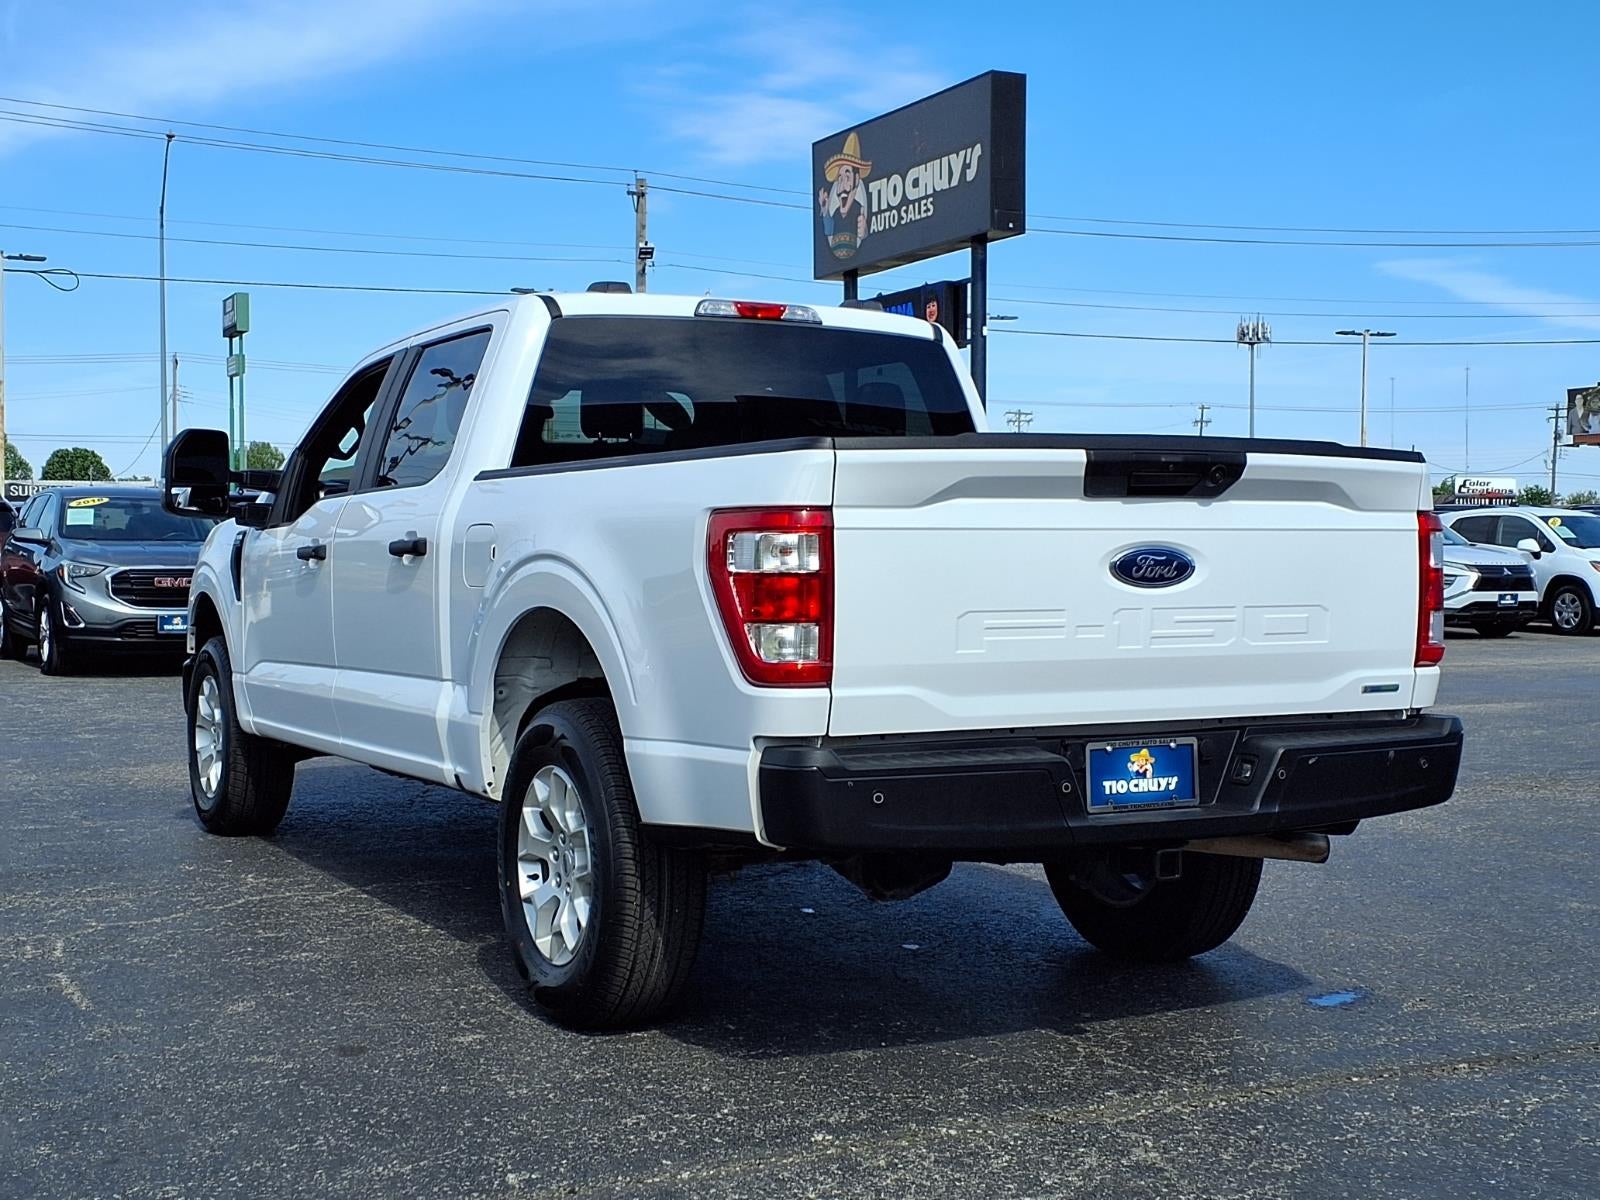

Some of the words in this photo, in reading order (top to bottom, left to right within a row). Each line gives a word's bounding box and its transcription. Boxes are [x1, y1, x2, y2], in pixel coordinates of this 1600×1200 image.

[869, 174, 903, 213] TIO
[905, 143, 982, 201] CHUY'S
[870, 209, 899, 234] AUTO
[900, 197, 934, 225] SALES
[1458, 484, 1514, 495] Creations
[1462, 478, 1492, 488] Color
[1132, 554, 1178, 578] Ford
[154, 577, 192, 588] GMC
[955, 604, 1329, 653] F-150
[1102, 779, 1129, 795] TIO
[1129, 776, 1178, 793] CHUY'S
